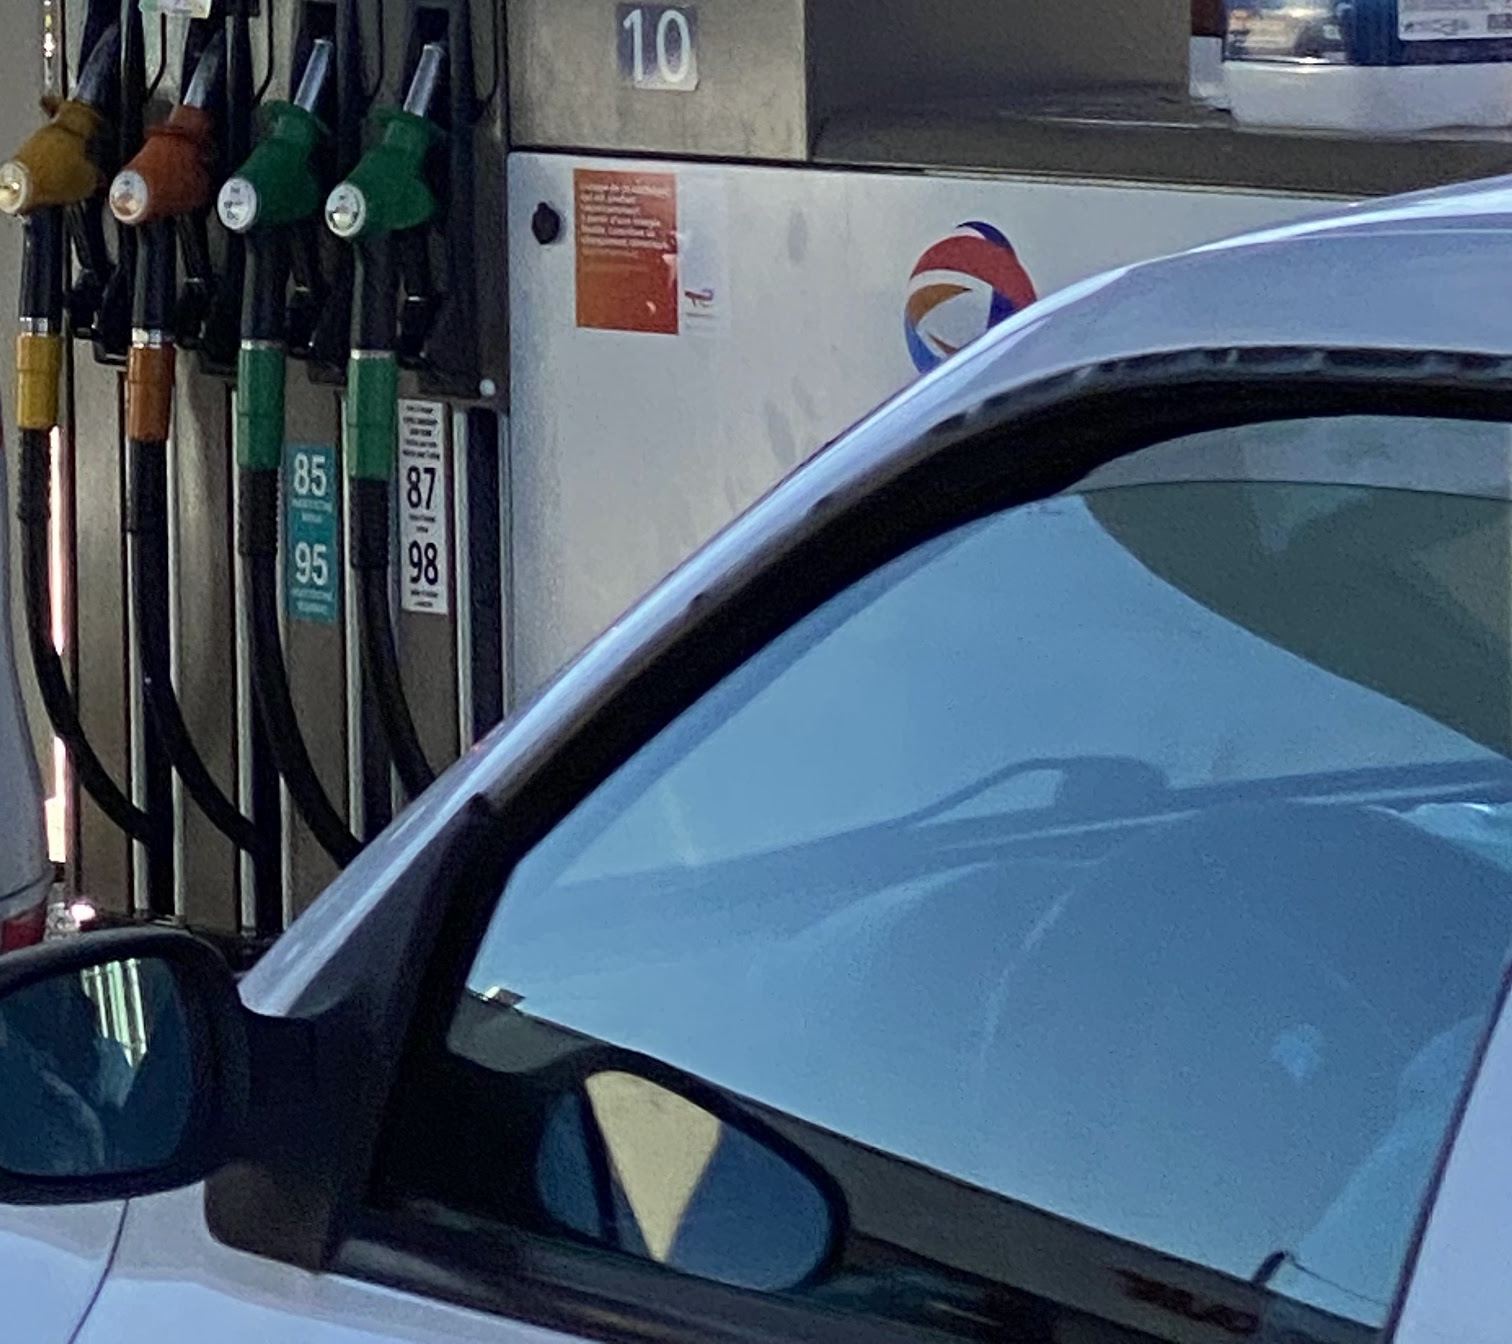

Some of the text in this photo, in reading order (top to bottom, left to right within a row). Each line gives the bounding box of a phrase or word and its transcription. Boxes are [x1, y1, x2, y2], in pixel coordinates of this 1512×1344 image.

[622, 8, 691, 84] 10
[293, 451, 328, 497] 85
[406, 465, 437, 511] 87
[294, 541, 329, 587] 95
[408, 540, 439, 586] 98
